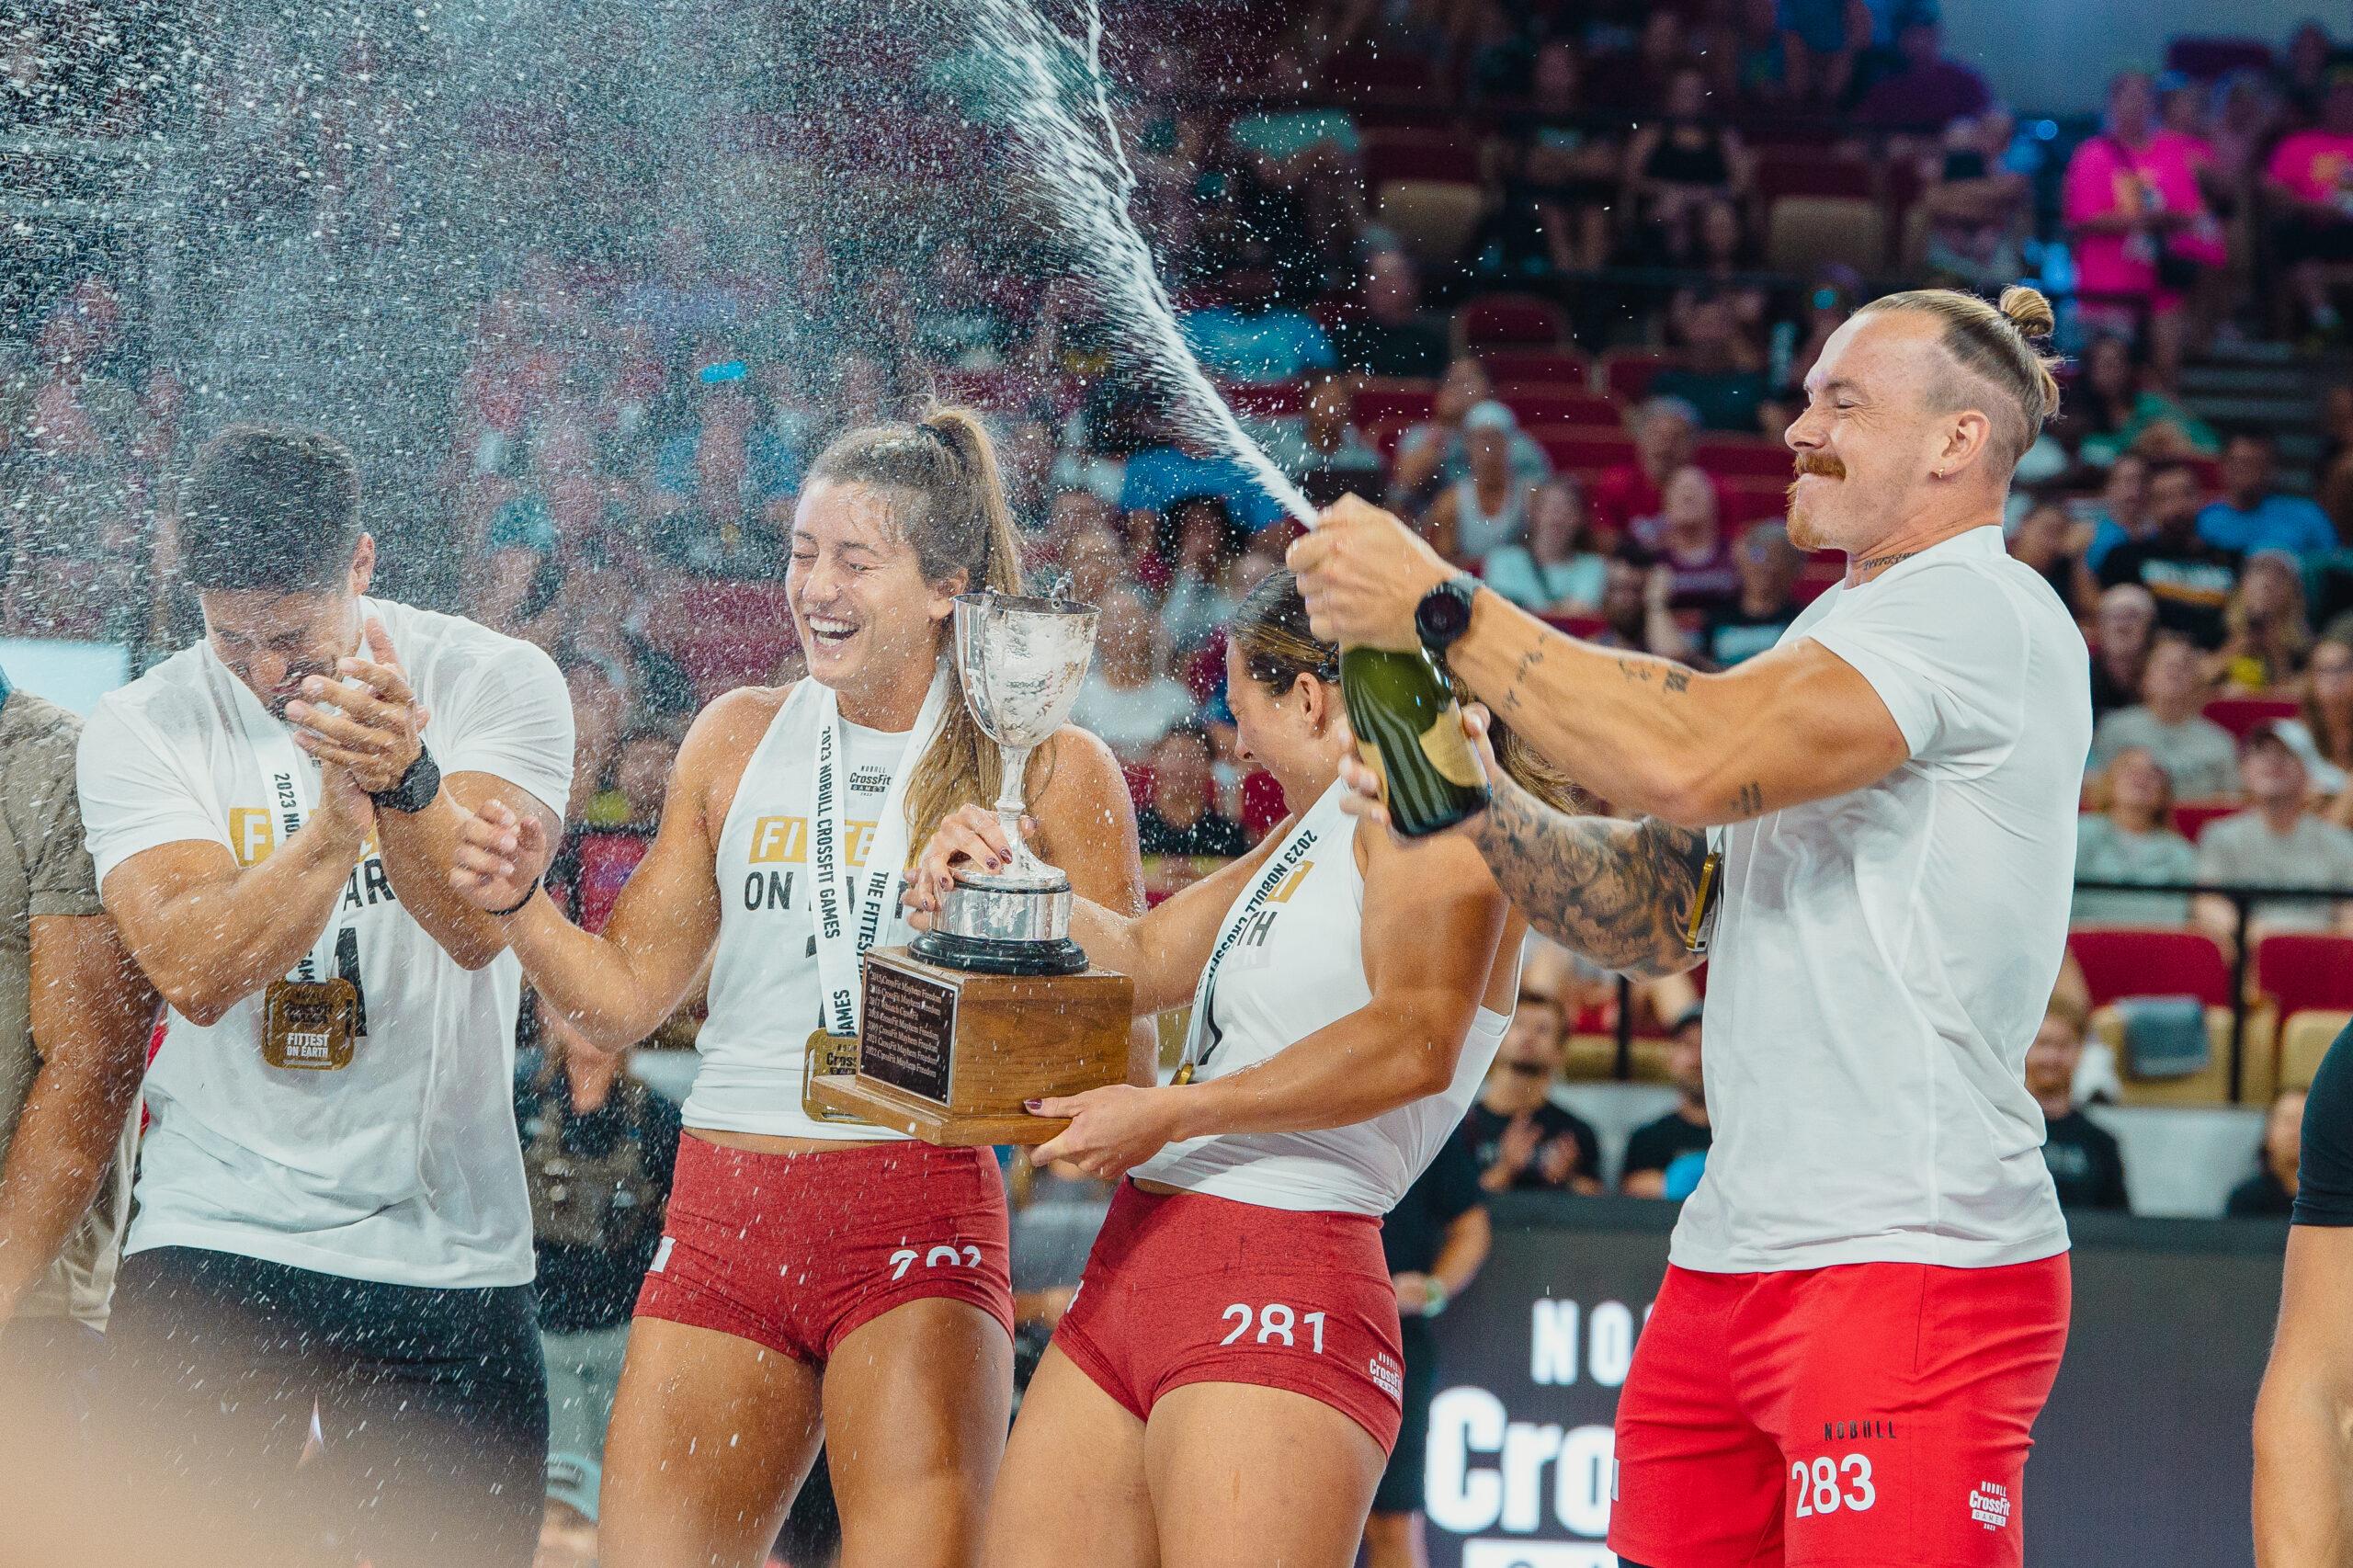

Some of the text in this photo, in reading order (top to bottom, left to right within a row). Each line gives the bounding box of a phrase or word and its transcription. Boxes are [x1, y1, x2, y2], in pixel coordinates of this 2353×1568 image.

[274, 772, 297, 808] 2023
[817, 765, 833, 817] NOBULL
[849, 772, 892, 785] CrossFit
[817, 819, 835, 882] CROSSFIT
[1284, 830, 1318, 864] 2023
[744, 871, 793, 910] ON
[868, 872, 889, 899] THE
[1245, 863, 1288, 913] NOBULL
[820, 888, 840, 939] GAMES
[287, 1033, 329, 1046] FITTEST
[287, 1047, 328, 1057] ON EARTH
[1220, 1303, 1325, 1354] 281
[1531, 1299, 1653, 1387] NO
[1824, 1421, 1896, 1440] NOBULL
[1426, 1386, 1616, 1537] Cro
[1792, 1454, 1876, 1517] 283
[1969, 1490, 2010, 1517] CrossFit
[1982, 1481, 2006, 1497] NOBULL
[1975, 1511, 2005, 1525] GAMES
